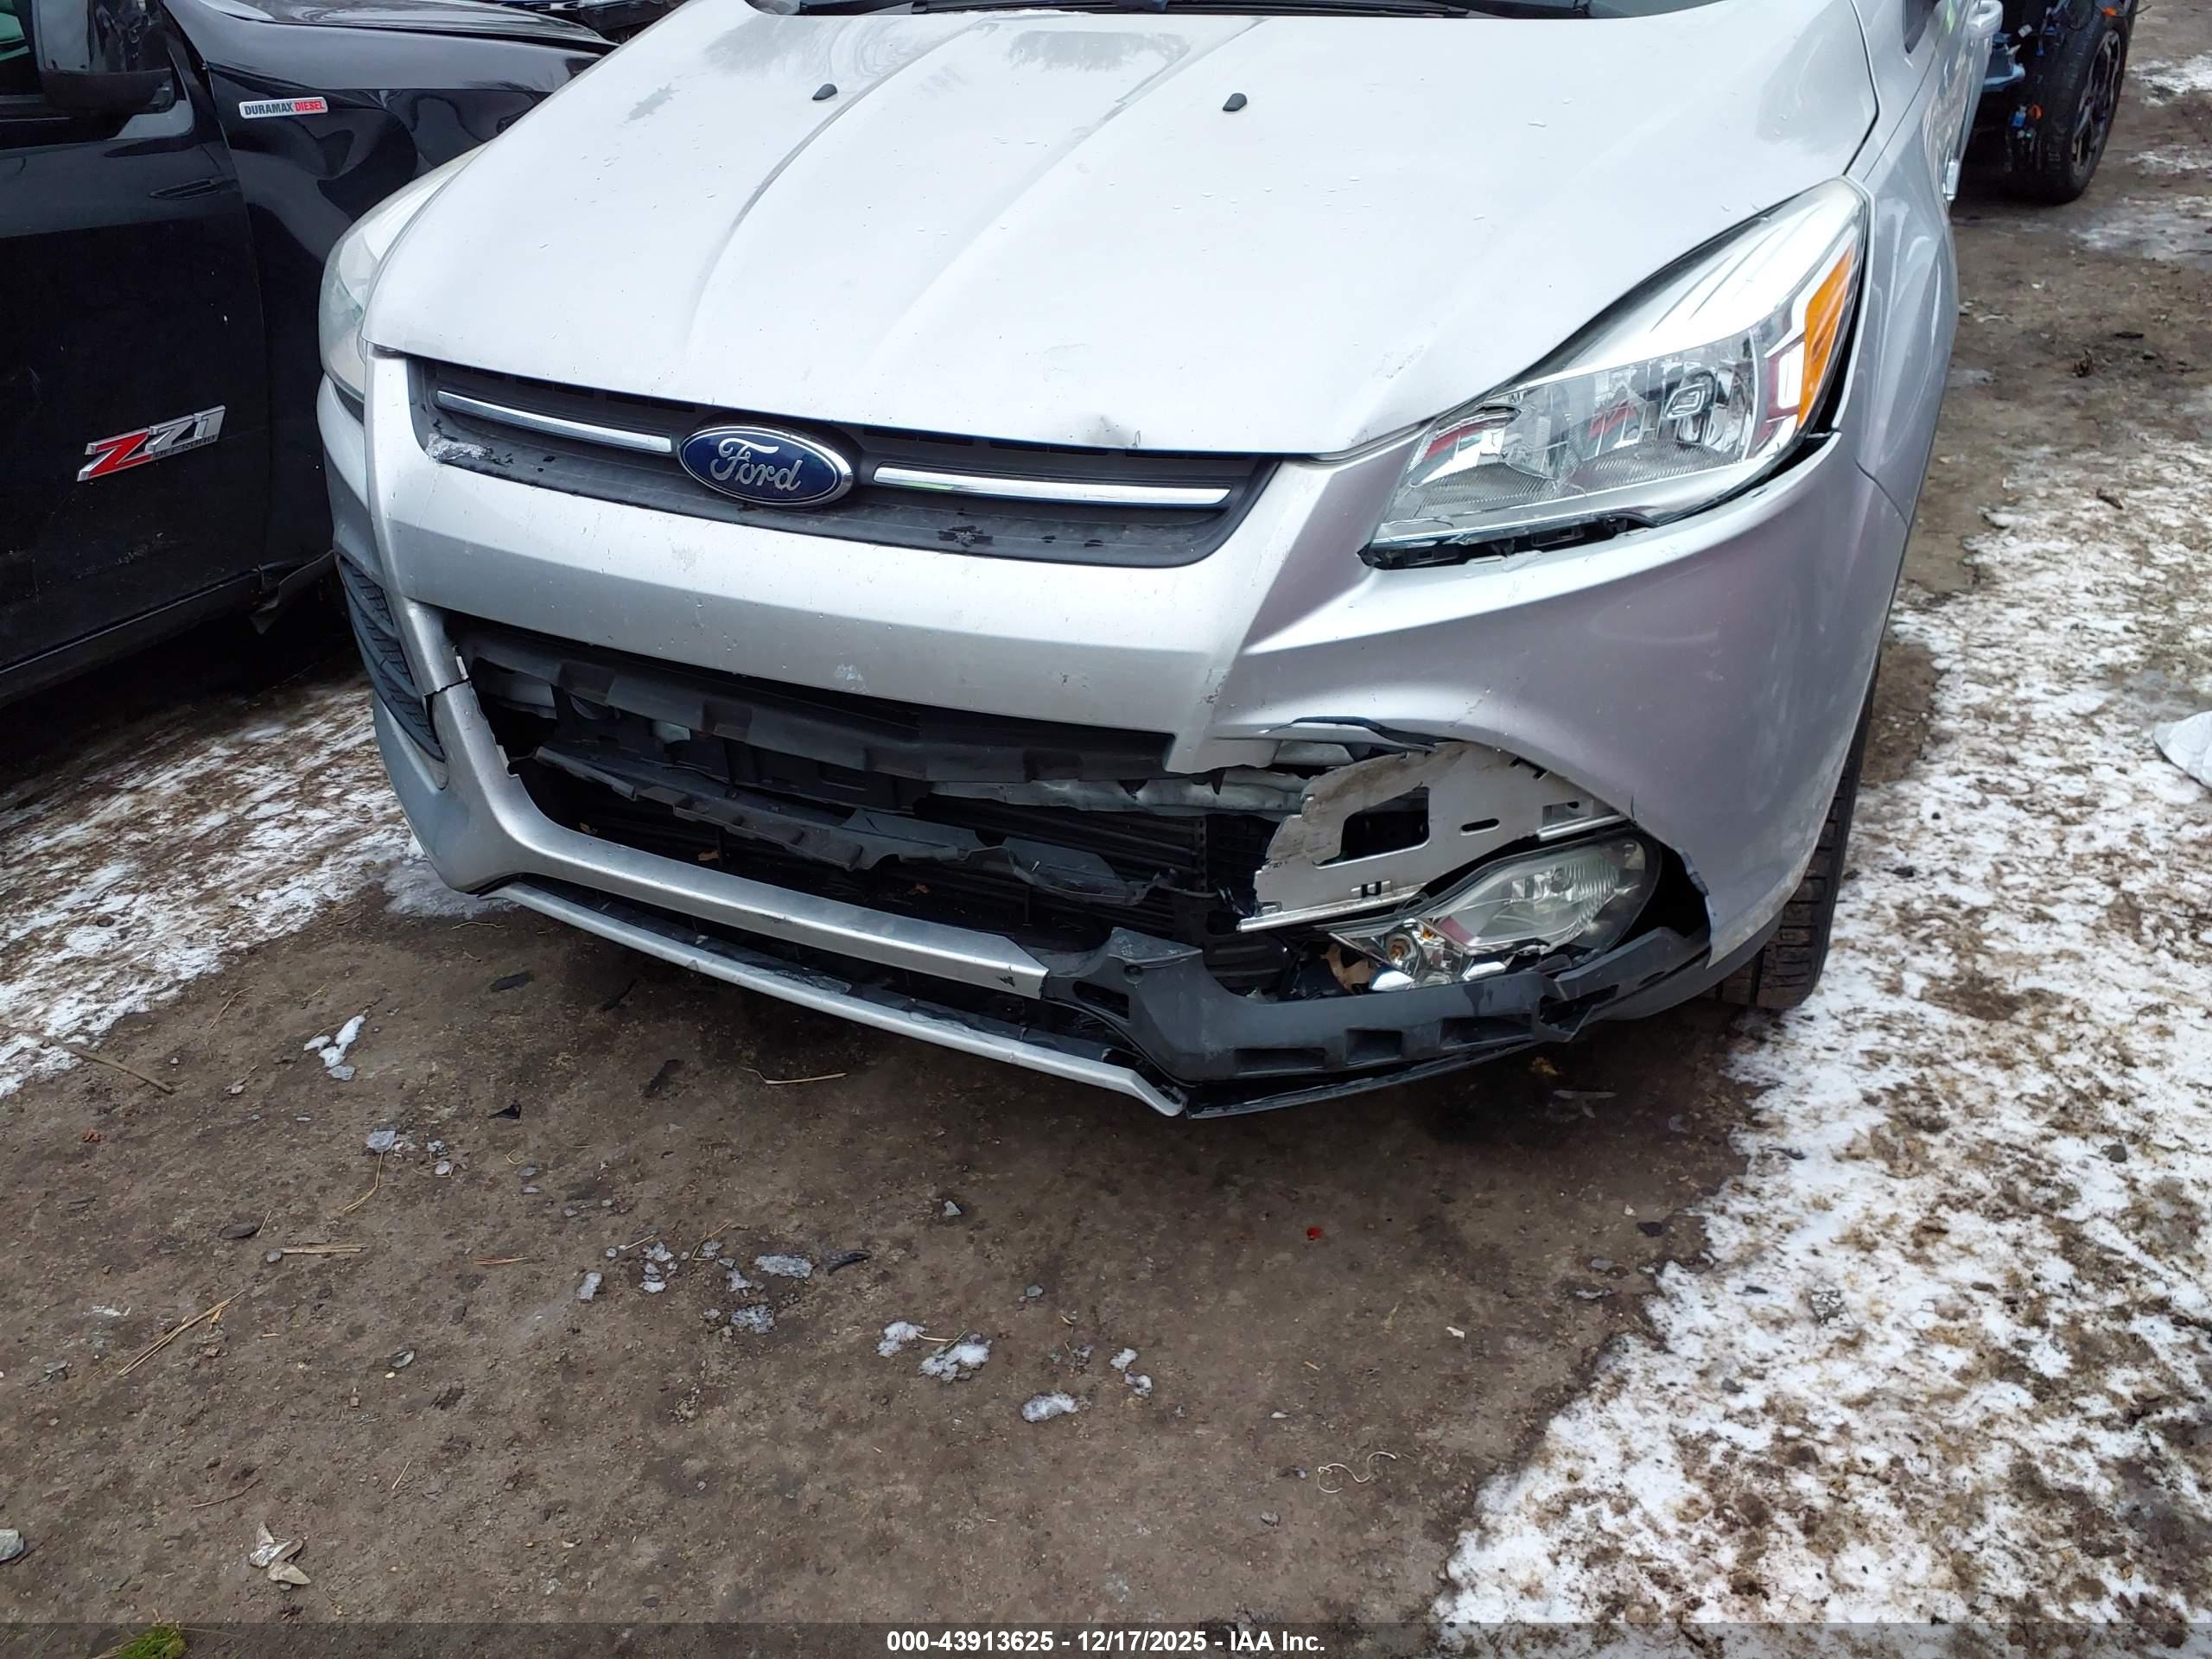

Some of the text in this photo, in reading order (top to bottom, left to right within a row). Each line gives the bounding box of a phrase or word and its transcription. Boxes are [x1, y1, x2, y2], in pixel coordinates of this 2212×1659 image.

[244, 101, 325, 115] DURAMAX DIESEL
[77, 404, 226, 482] Z71
[709, 437, 804, 492] Ford
